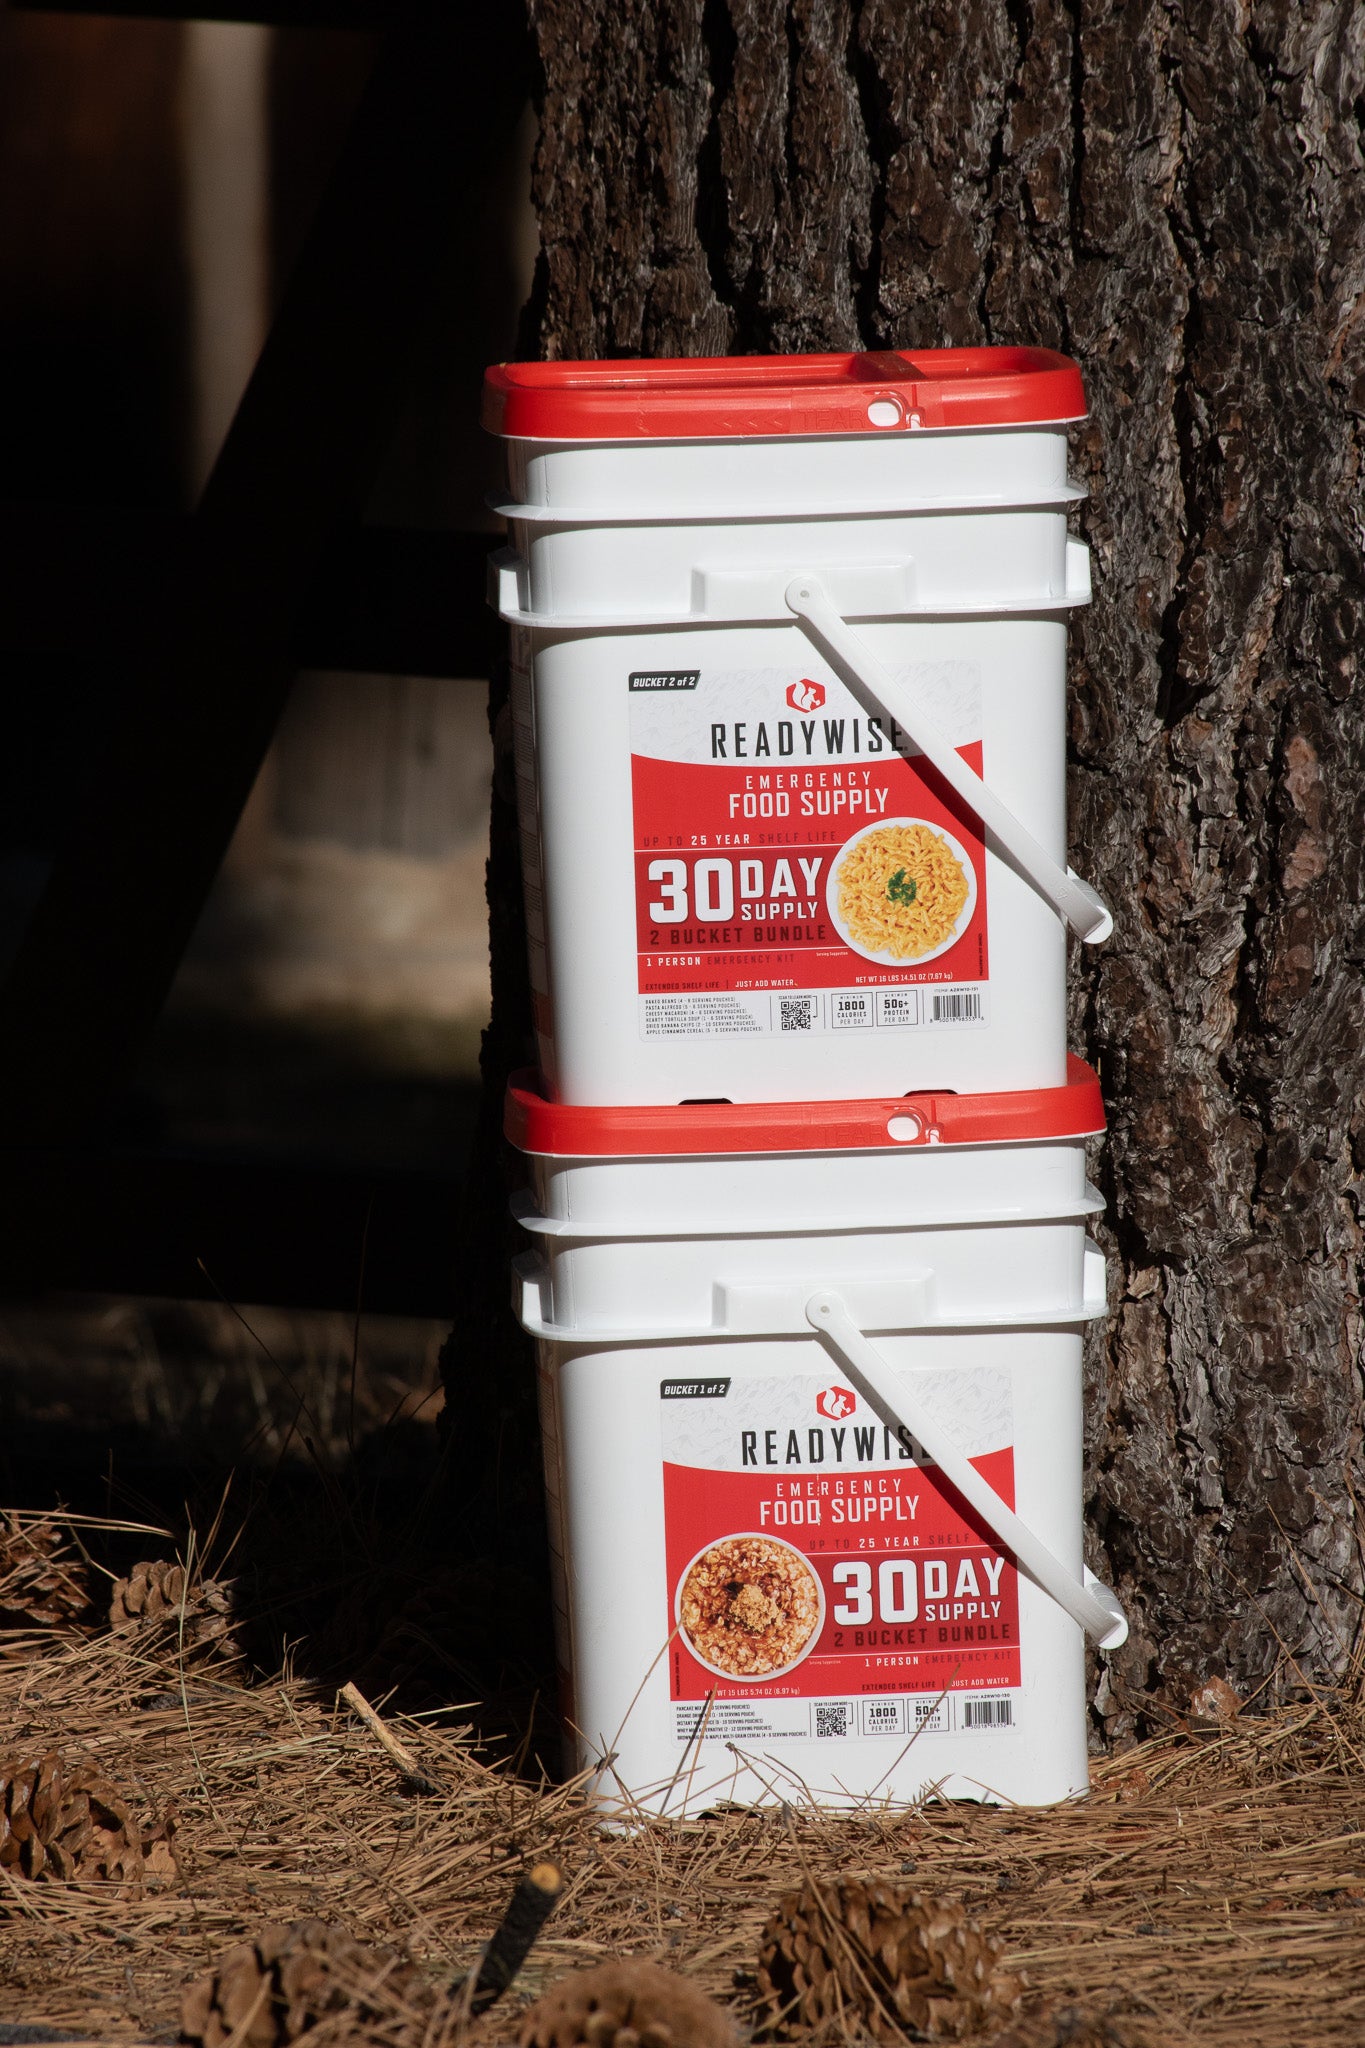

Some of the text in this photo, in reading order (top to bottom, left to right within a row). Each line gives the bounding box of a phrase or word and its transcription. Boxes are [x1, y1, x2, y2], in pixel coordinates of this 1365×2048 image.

[633, 677, 695, 687] BUCKET 2 of 2
[712, 717, 904, 758] READYWISE
[746, 771, 870, 789] EMERGENCY
[730, 788, 889, 819] FOOD SUPPLY
[644, 831, 836, 846] UP TO 25 YEAR SHELF LIFE
[648, 858, 822, 923] 30 DAY
[741, 902, 818, 920] SUPPLY
[651, 925, 826, 945] 2 BUCKET BUNDLE
[647, 954, 794, 966] 1 PERSON EMERGENCY KIT
[901, 974, 916, 982] 14.51
[838, 1001, 865, 1010] 1800
[665, 1384, 725, 1395] BUCKET 1 of 2
[777, 1478, 901, 1497] EMERGENCY
[760, 1495, 919, 1526] FOOD SUPPLY
[810, 1540, 824, 1550] UP
[836, 1540, 849, 1549] TO
[859, 1538, 875, 1548] 25
[885, 1536, 920, 1547] YEAR
[929, 1534, 969, 1545] SHELF
[833, 1557, 1005, 1626] 30 DAY
[925, 1601, 1001, 1622] SUPPLY
[834, 1624, 1010, 1647] 2 BUCKET BUNDLE
[876, 1656, 919, 1666] PERSON
[925, 1653, 987, 1664] EMERGENCY
[994, 1651, 1012, 1660] KIT
[870, 1708, 896, 1717] 1800
